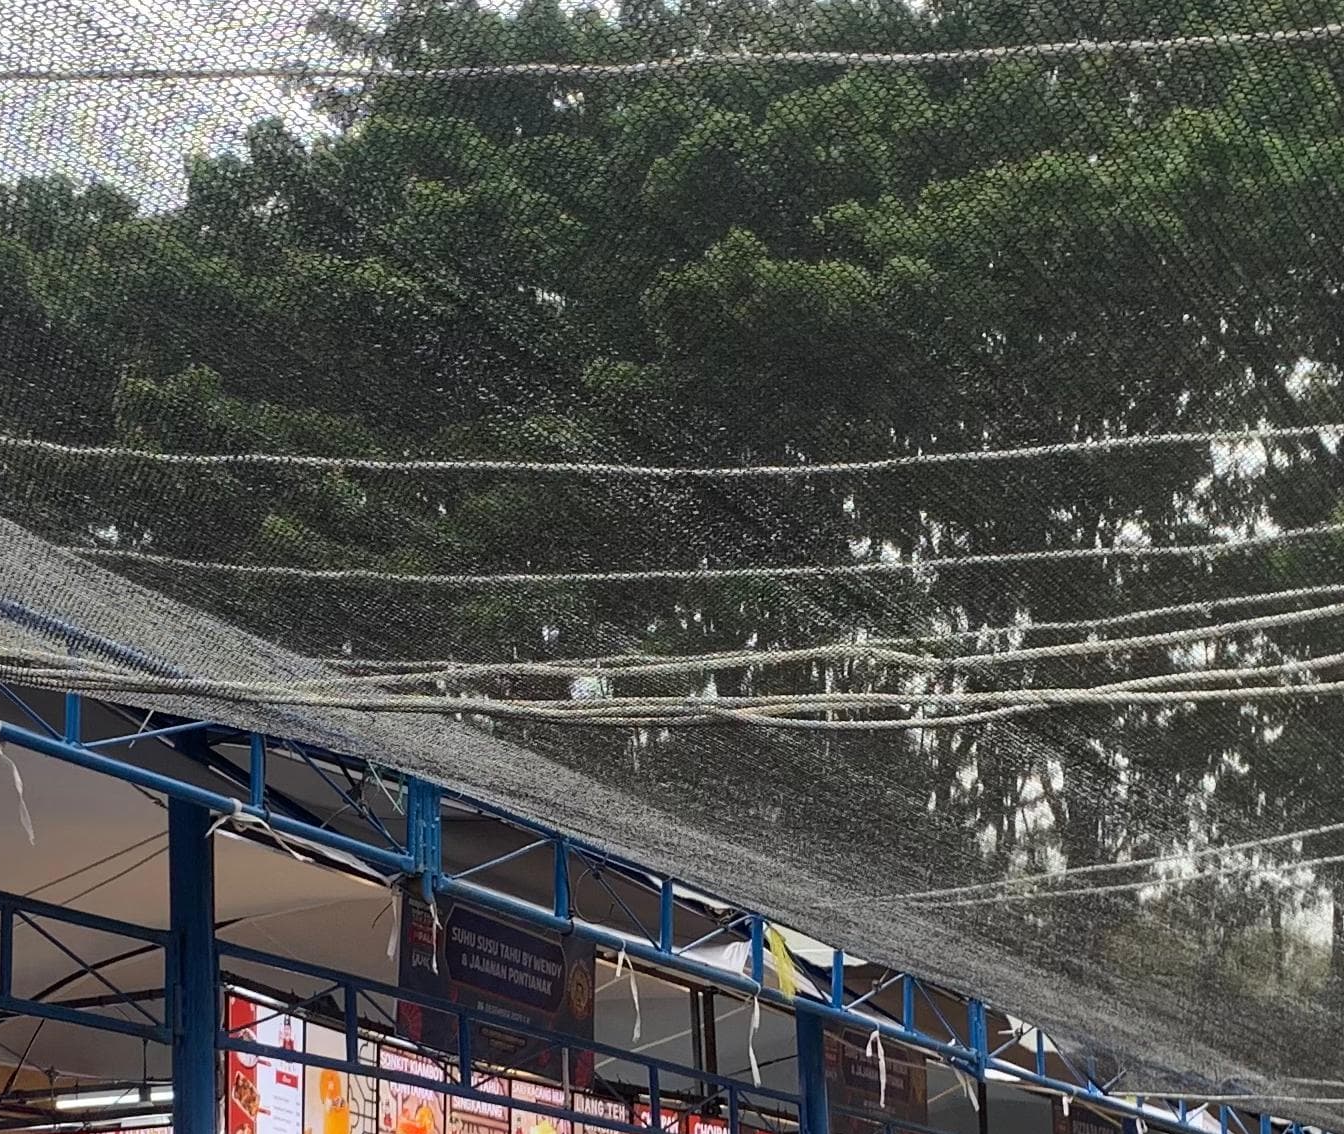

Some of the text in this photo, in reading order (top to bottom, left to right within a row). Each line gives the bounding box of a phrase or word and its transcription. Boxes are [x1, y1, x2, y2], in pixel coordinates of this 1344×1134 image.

[452, 926, 563, 978] SUHU SUSU TAHU BY WENDY
[469, 955, 507, 981] JAJANAN
[508, 967, 554, 996] PONTIANAK
[574, 1093, 626, 1120] LIANG TEH
